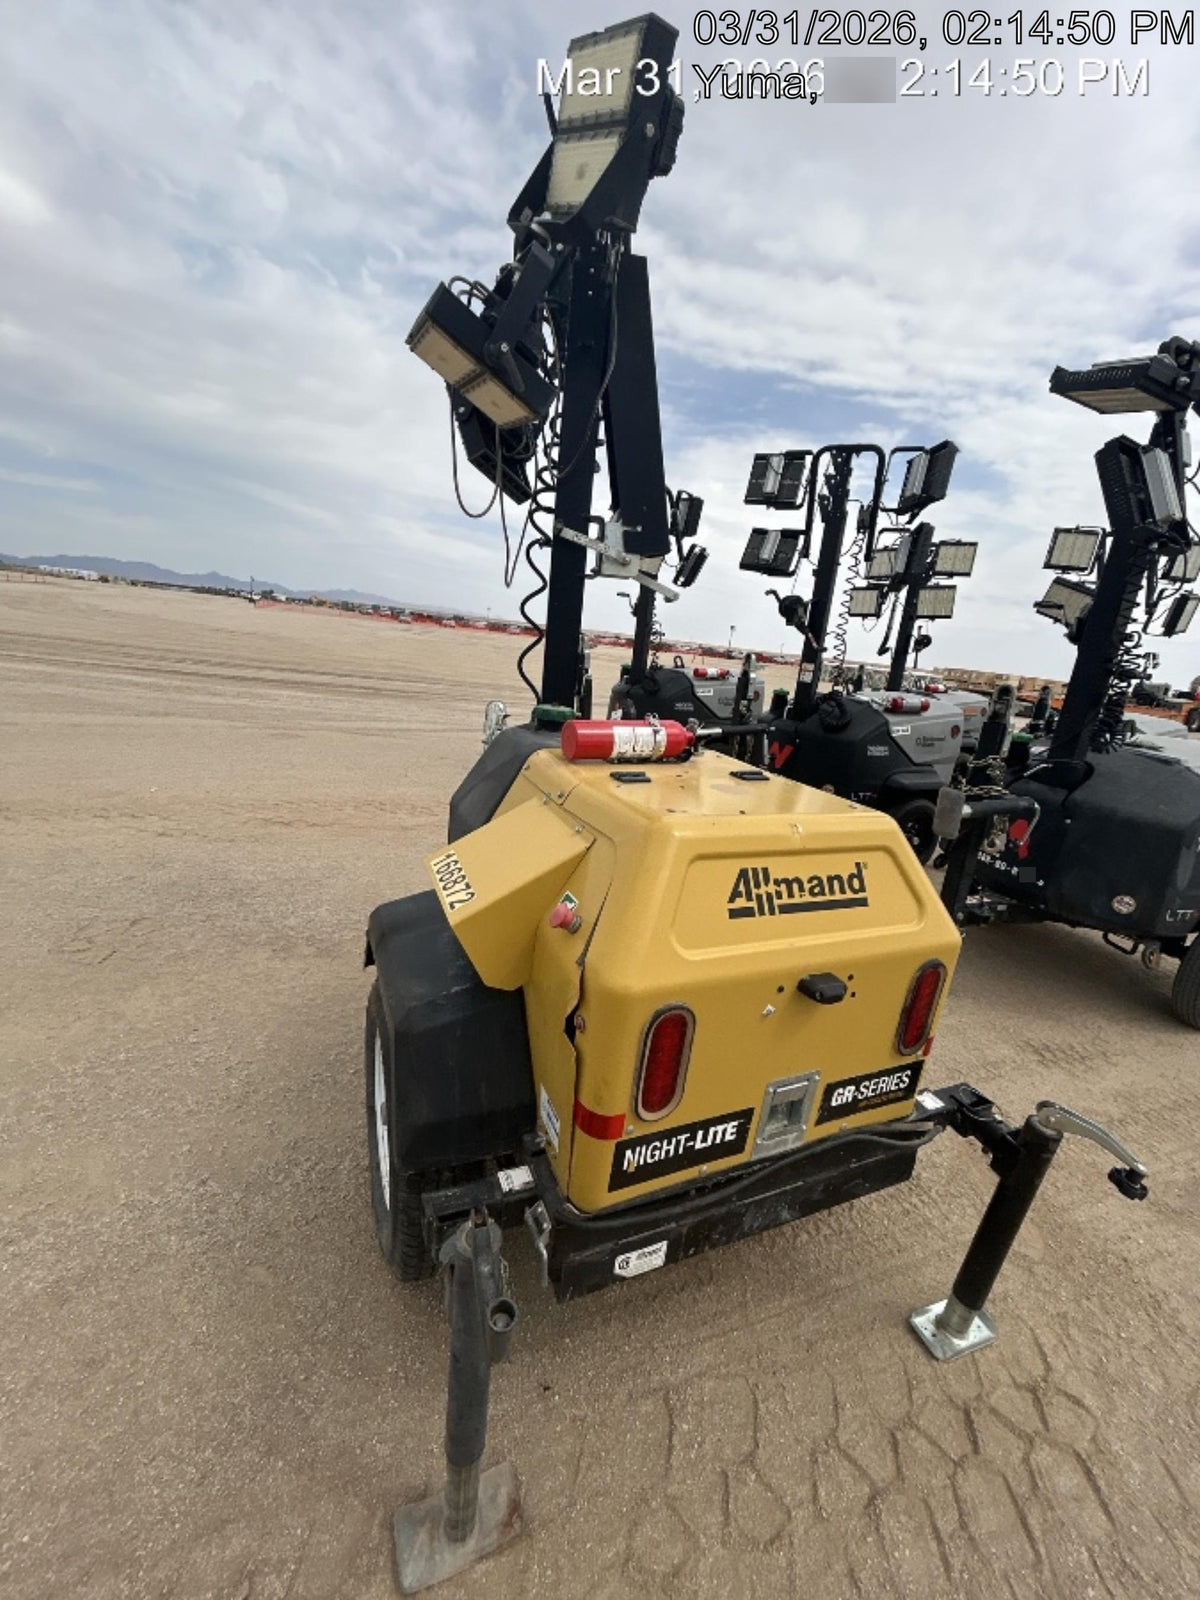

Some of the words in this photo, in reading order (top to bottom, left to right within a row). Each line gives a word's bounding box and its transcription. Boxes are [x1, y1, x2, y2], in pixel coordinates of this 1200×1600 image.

[433, 852, 476, 911] 166872
[830, 1069, 912, 1107] GR-SERIES
[622, 1119, 744, 1173] NIGHT-LITE
